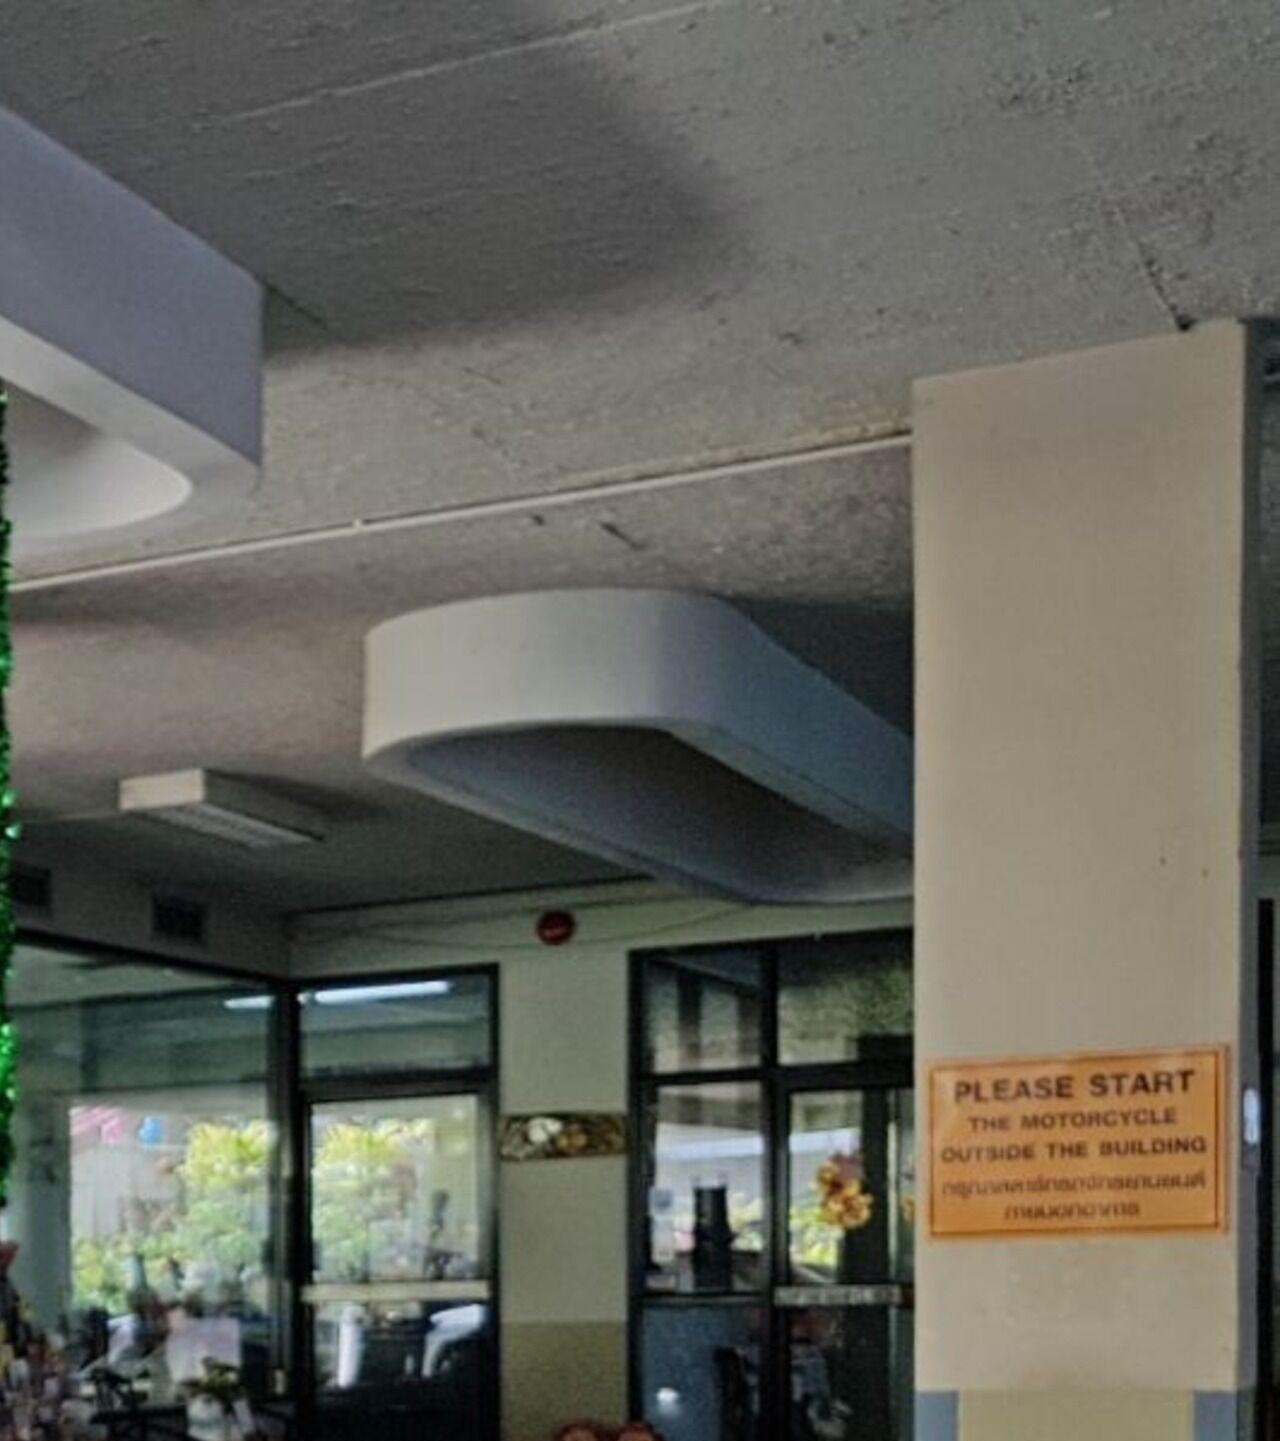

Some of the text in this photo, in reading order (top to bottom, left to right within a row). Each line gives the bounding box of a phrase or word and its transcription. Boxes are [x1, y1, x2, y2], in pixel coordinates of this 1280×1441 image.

[954, 1069, 1195, 1104] PLEASE START
[967, 1106, 1177, 1133] THE MOTORCYCLE
[941, 1135, 1207, 1164] OUTSIDE THE BUILDING
